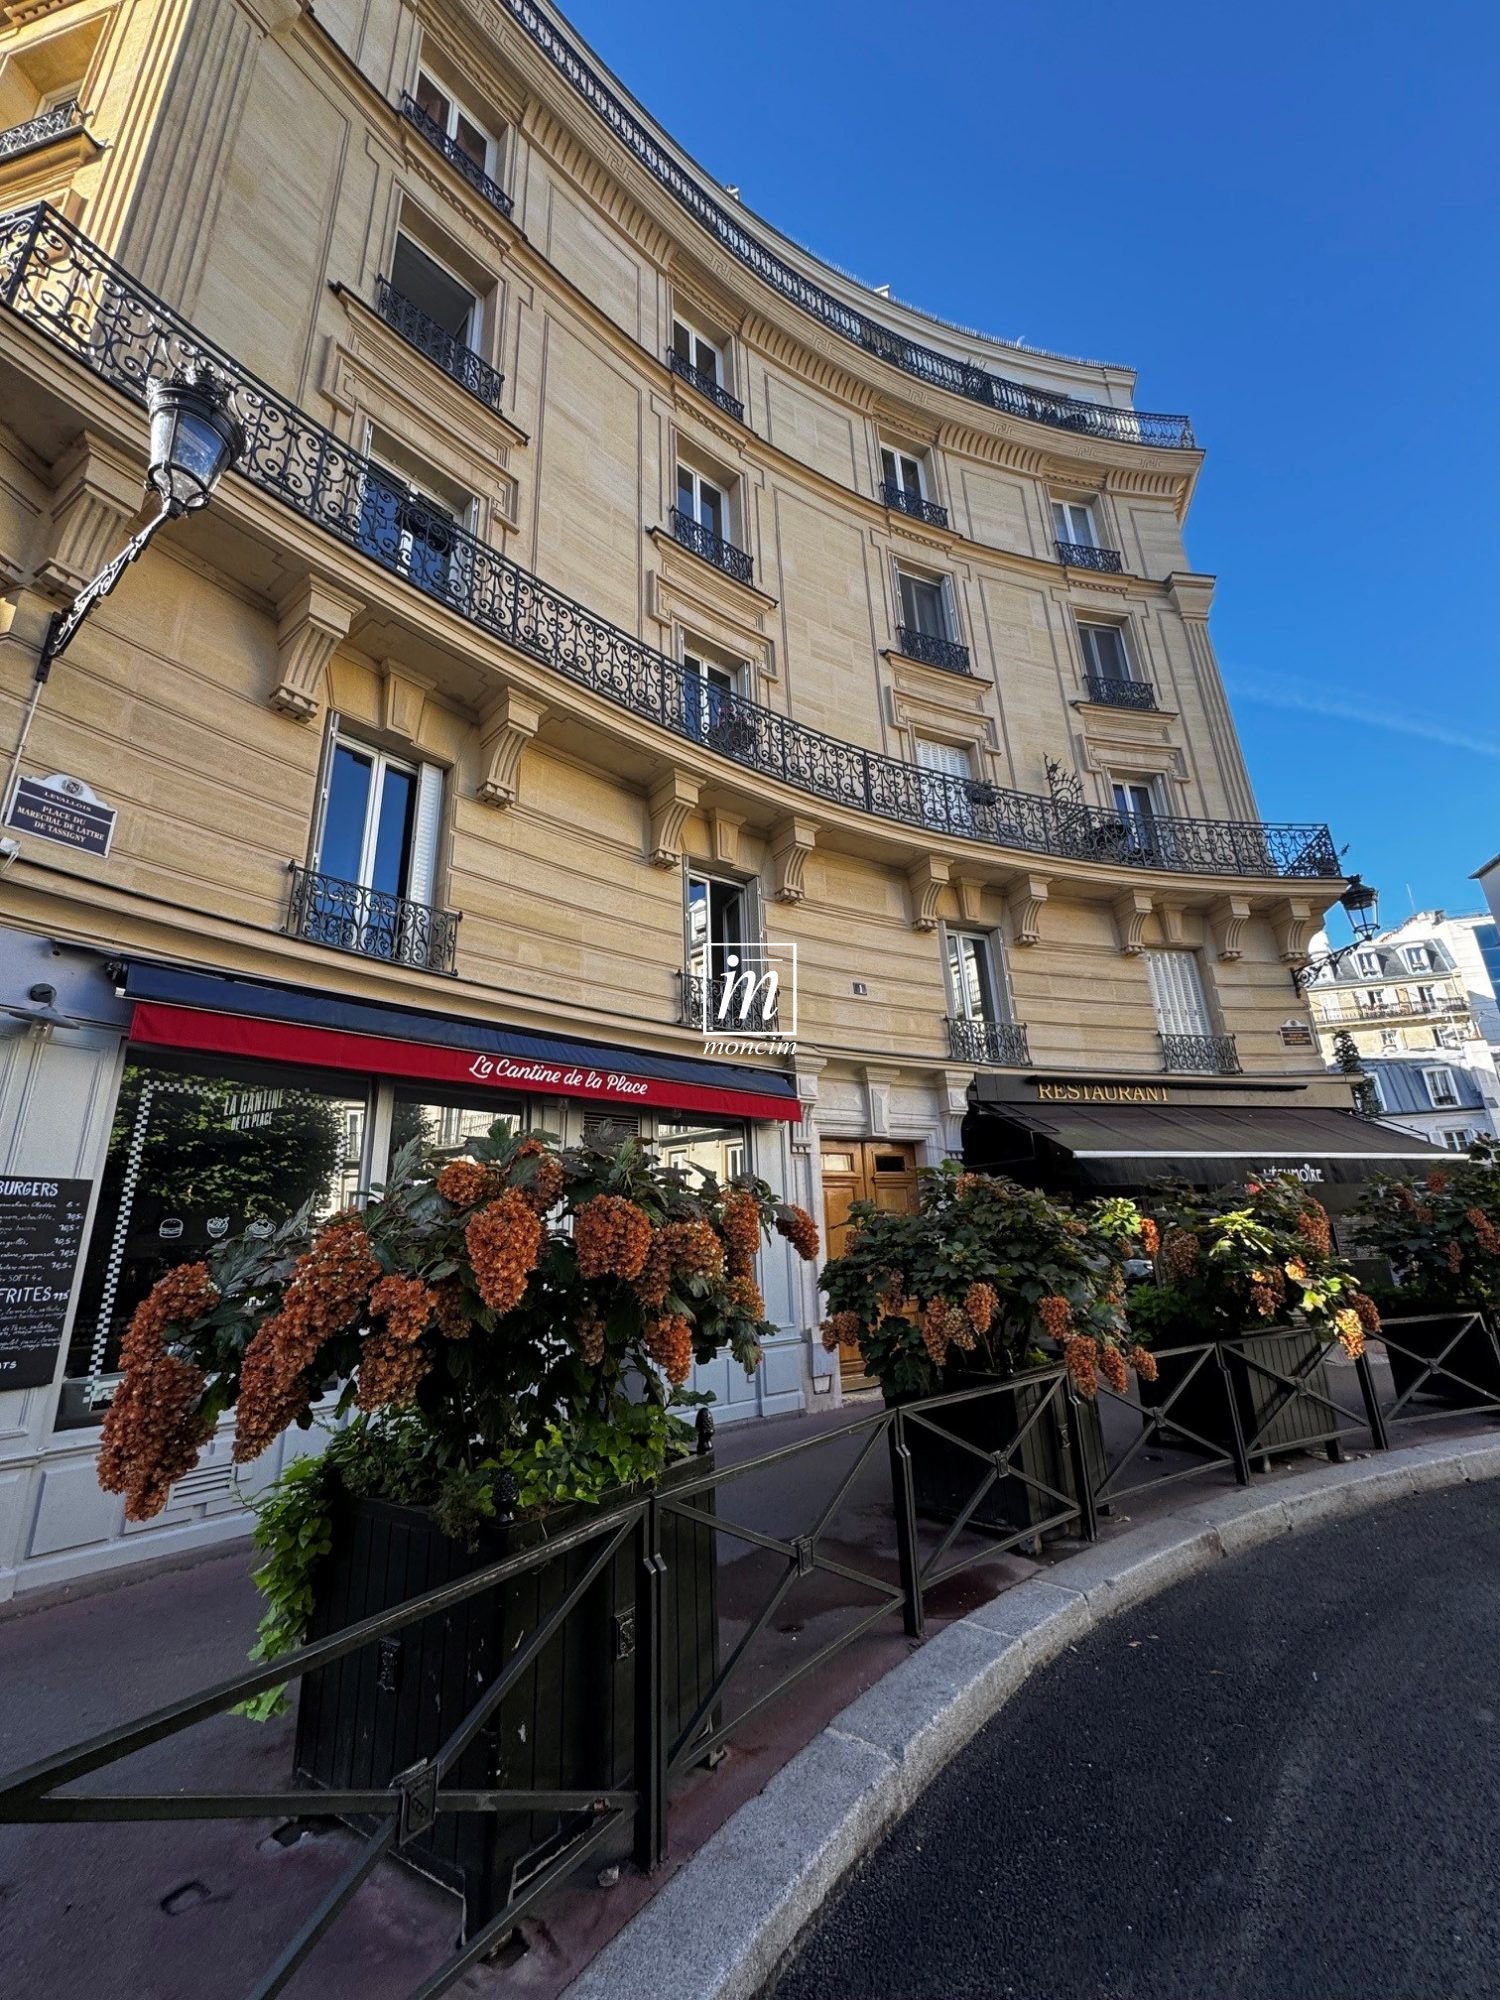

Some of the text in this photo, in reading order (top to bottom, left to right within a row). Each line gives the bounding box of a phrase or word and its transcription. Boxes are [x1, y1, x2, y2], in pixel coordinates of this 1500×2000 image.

[44, 791, 92, 812] LEVALLOIS
[17, 806, 105, 840] MARECHAL DE LATTRE
[42, 805, 87, 825] PLACE DU
[34, 820, 87, 843] DE TASSIGNY
[469, 1054, 648, 1095] La Cantine de la Place
[223, 1089, 285, 1116] LA CANTINE
[1039, 1083, 1169, 1102] RESTAURANT
[231, 1112, 273, 1131] DE LA PLACE
